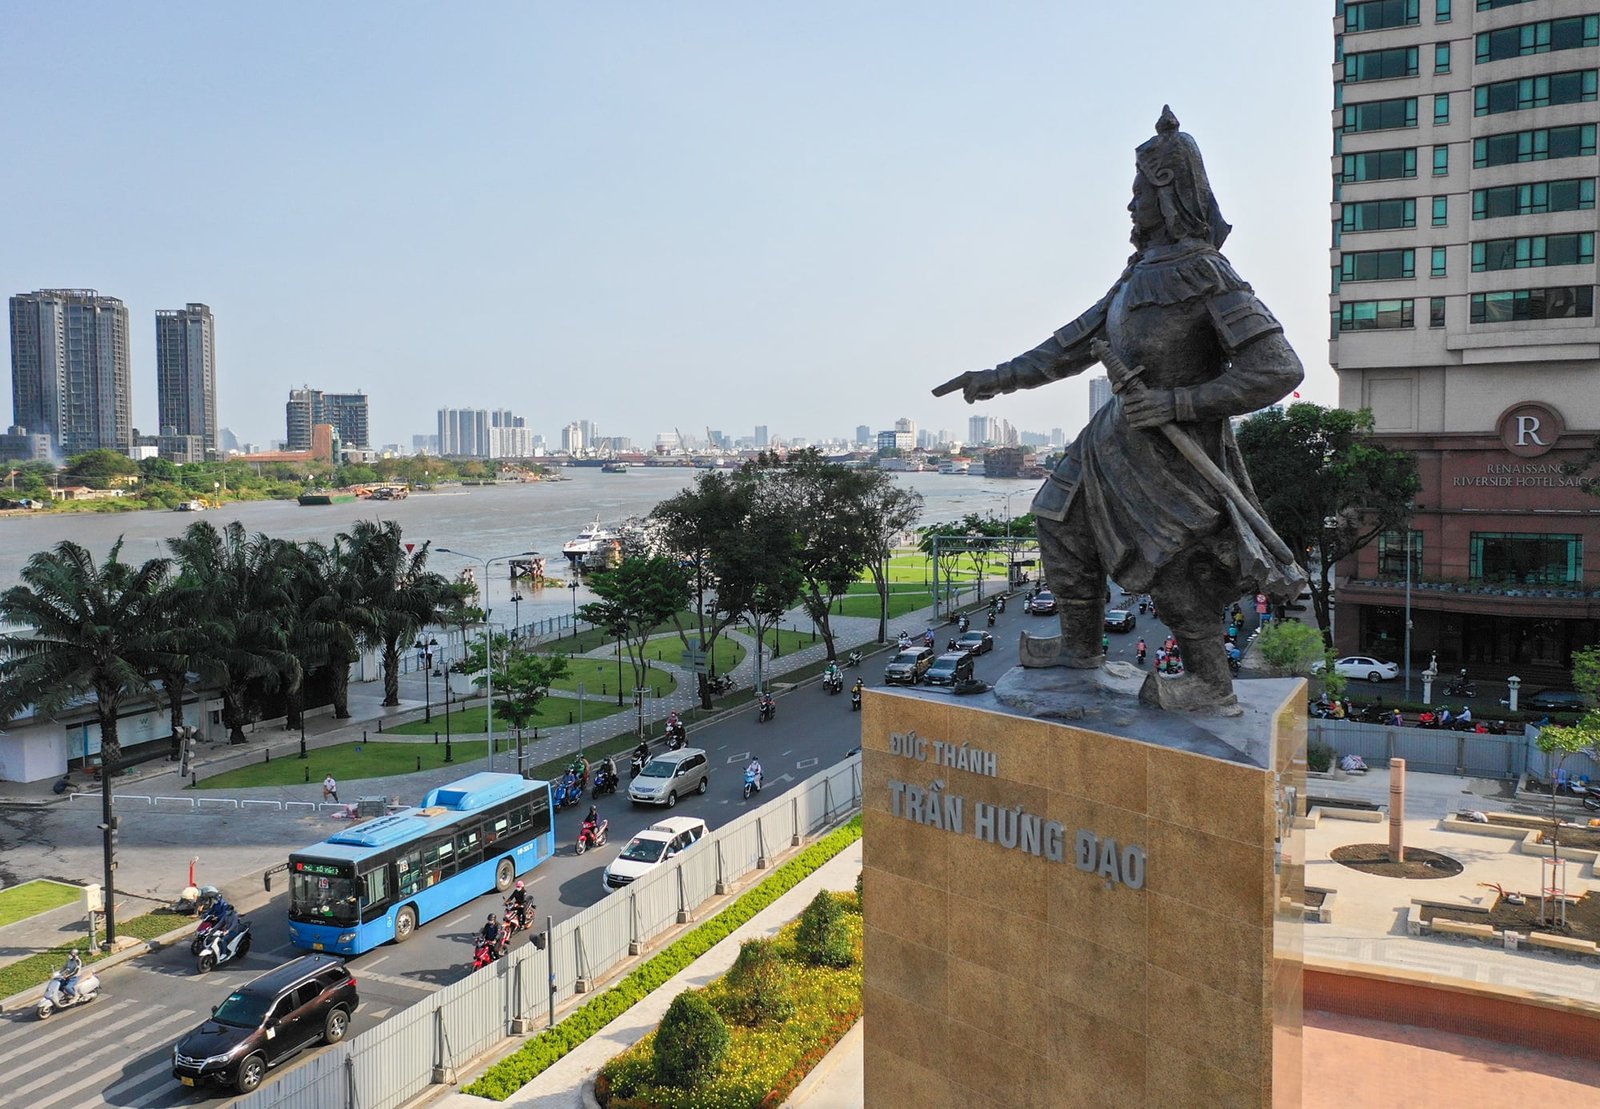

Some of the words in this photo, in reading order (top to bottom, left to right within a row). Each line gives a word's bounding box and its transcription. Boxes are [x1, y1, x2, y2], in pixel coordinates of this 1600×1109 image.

[1515, 416, 1550, 446] R
[1487, 464, 1570, 474] RENAISSANC
[1453, 476, 1512, 487] RIVERSIDE
[1516, 476, 1556, 488] HOTEL
[890, 731, 928, 761] ĐỨC
[933, 741, 997, 777] THÁNH
[888, 778, 964, 834] TRẦN
[975, 803, 1065, 863] HƯNG
[1076, 828, 1146, 890] ĐẠO
[319, 879, 329, 888] 19
